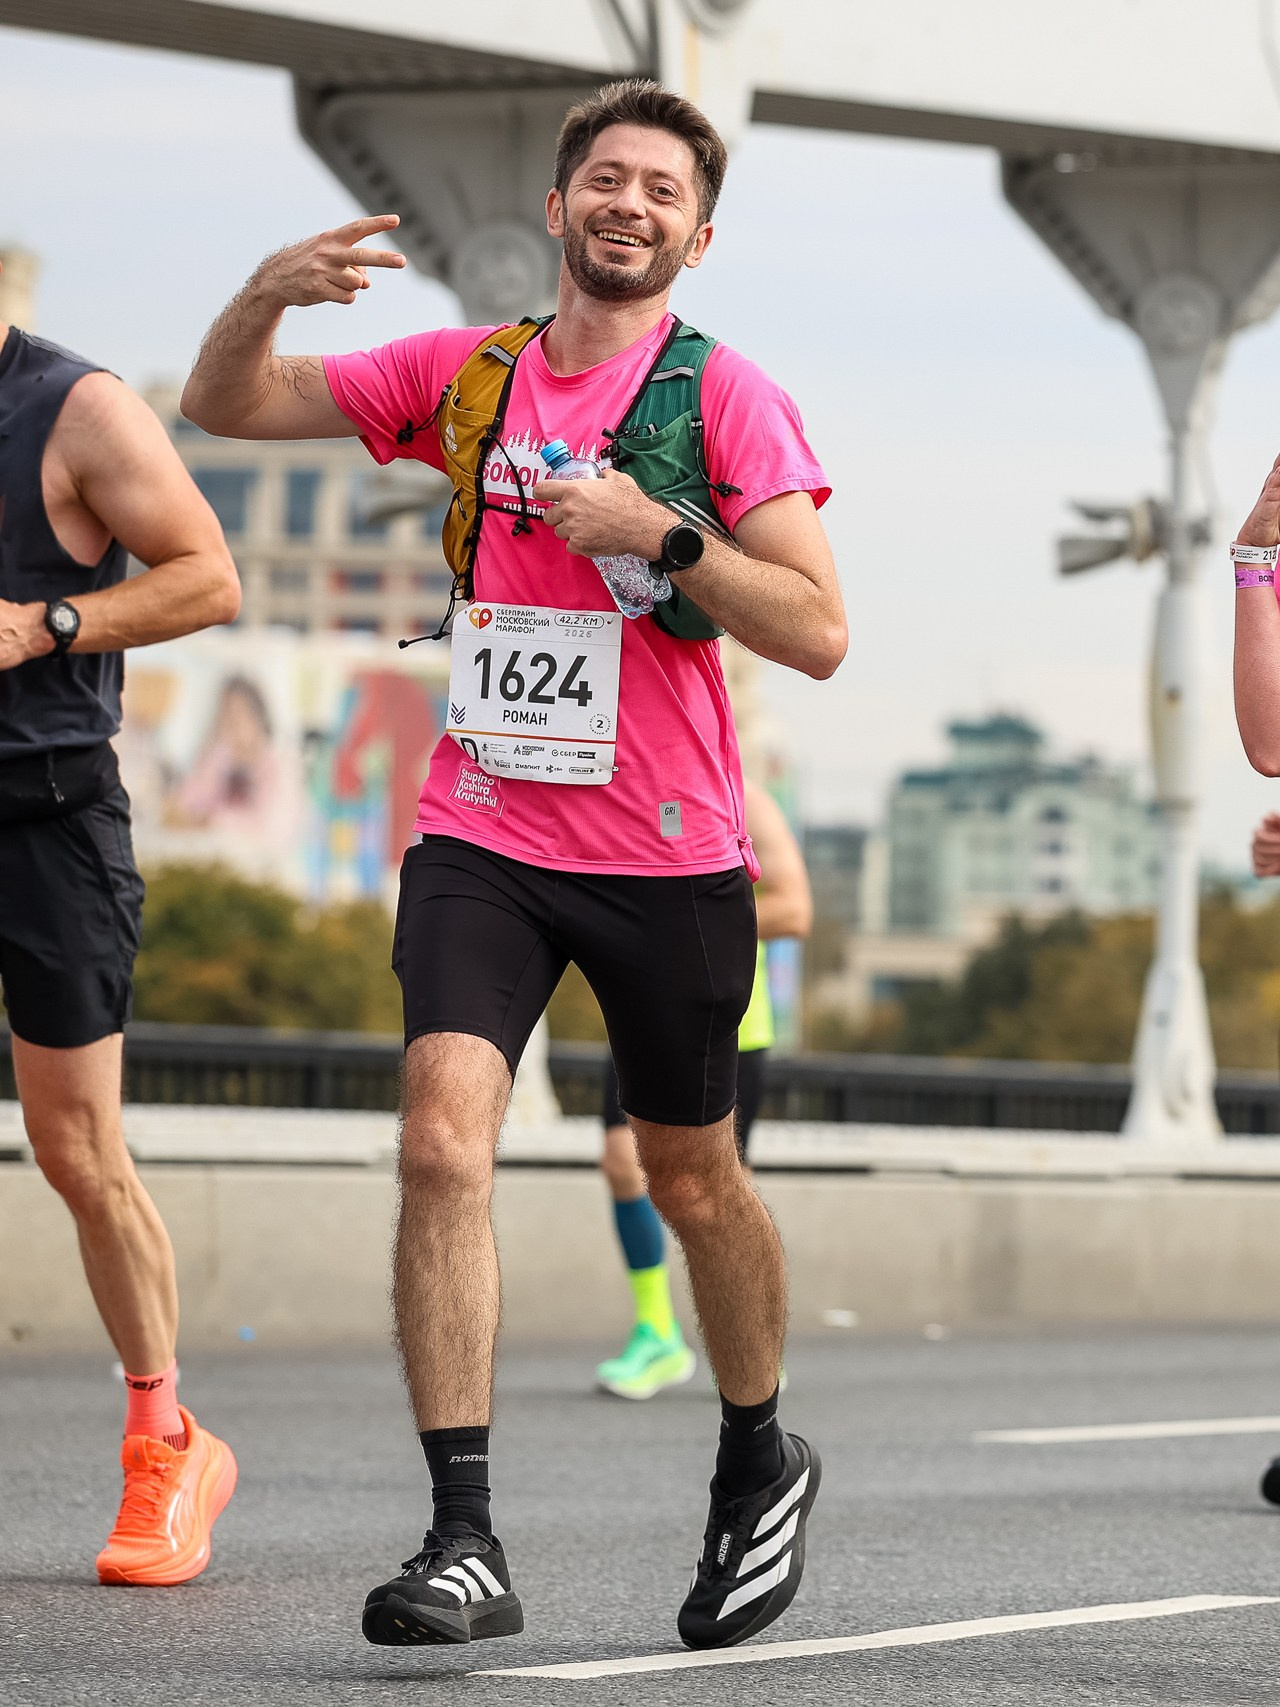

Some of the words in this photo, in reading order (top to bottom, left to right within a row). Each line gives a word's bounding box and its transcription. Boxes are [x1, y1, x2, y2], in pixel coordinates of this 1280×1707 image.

[496, 608, 536, 618] СБЕРПРАЙМ
[496, 616, 550, 627] МОСКОВСКИЙ
[559, 616, 580, 625] 42,2
[582, 617, 598, 626] КМ
[495, 625, 535, 635] МАРАФОН
[474, 648, 593, 707] 1624
[502, 709, 548, 726] РОМАН
[596, 719, 604, 729] 2
[461, 768, 495, 786] Stupino
[459, 778, 491, 796] Kashira
[454, 788, 498, 808] Krutyshki
[717, 1533, 731, 1566] ADIZERO
